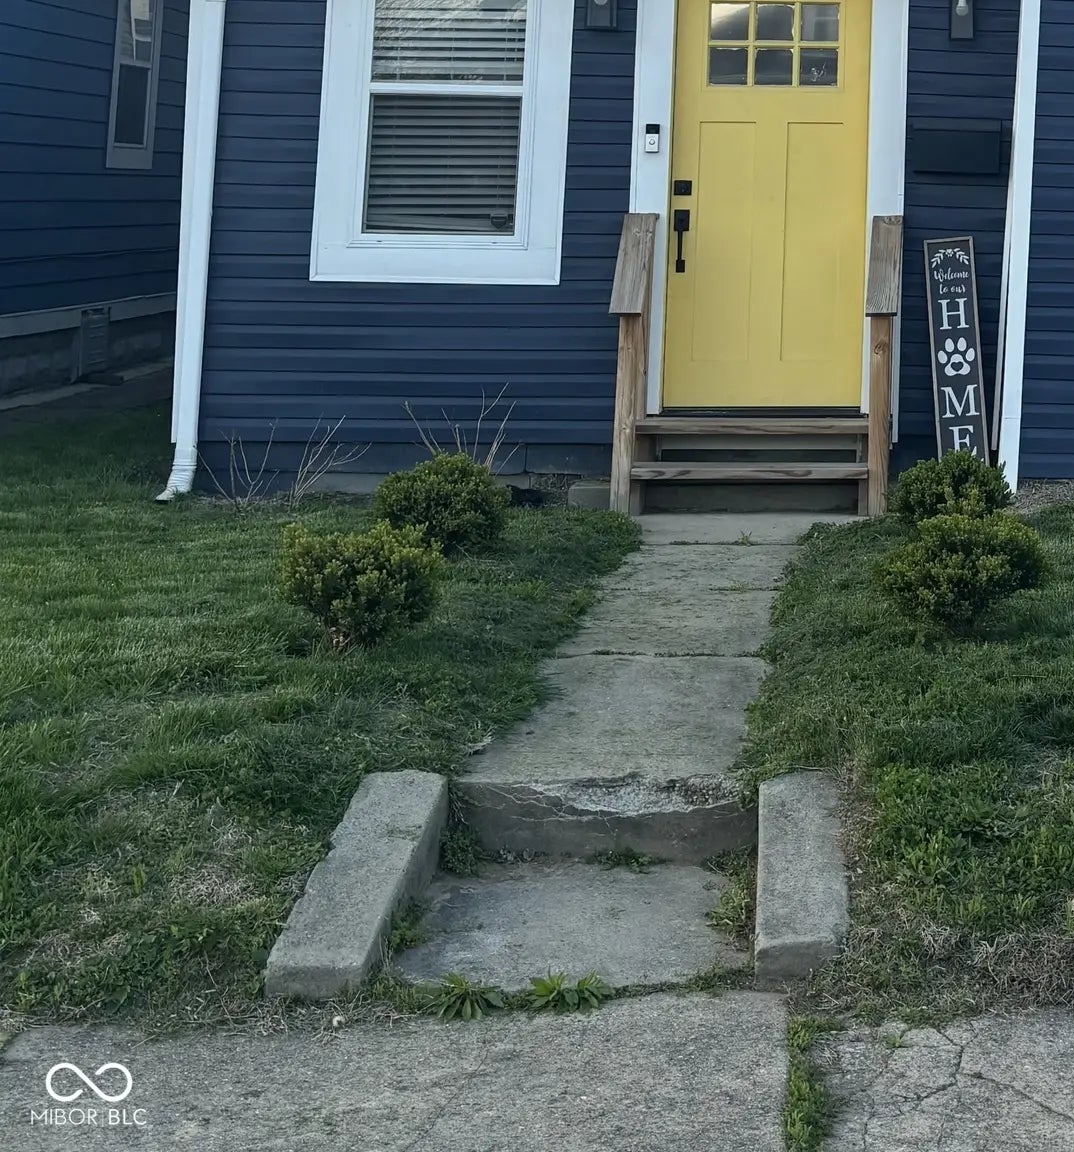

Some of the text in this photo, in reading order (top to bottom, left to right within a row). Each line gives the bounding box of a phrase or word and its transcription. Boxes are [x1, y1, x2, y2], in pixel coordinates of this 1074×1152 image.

[934, 268, 969, 282] Welcome
[940, 284, 965, 294] to our
